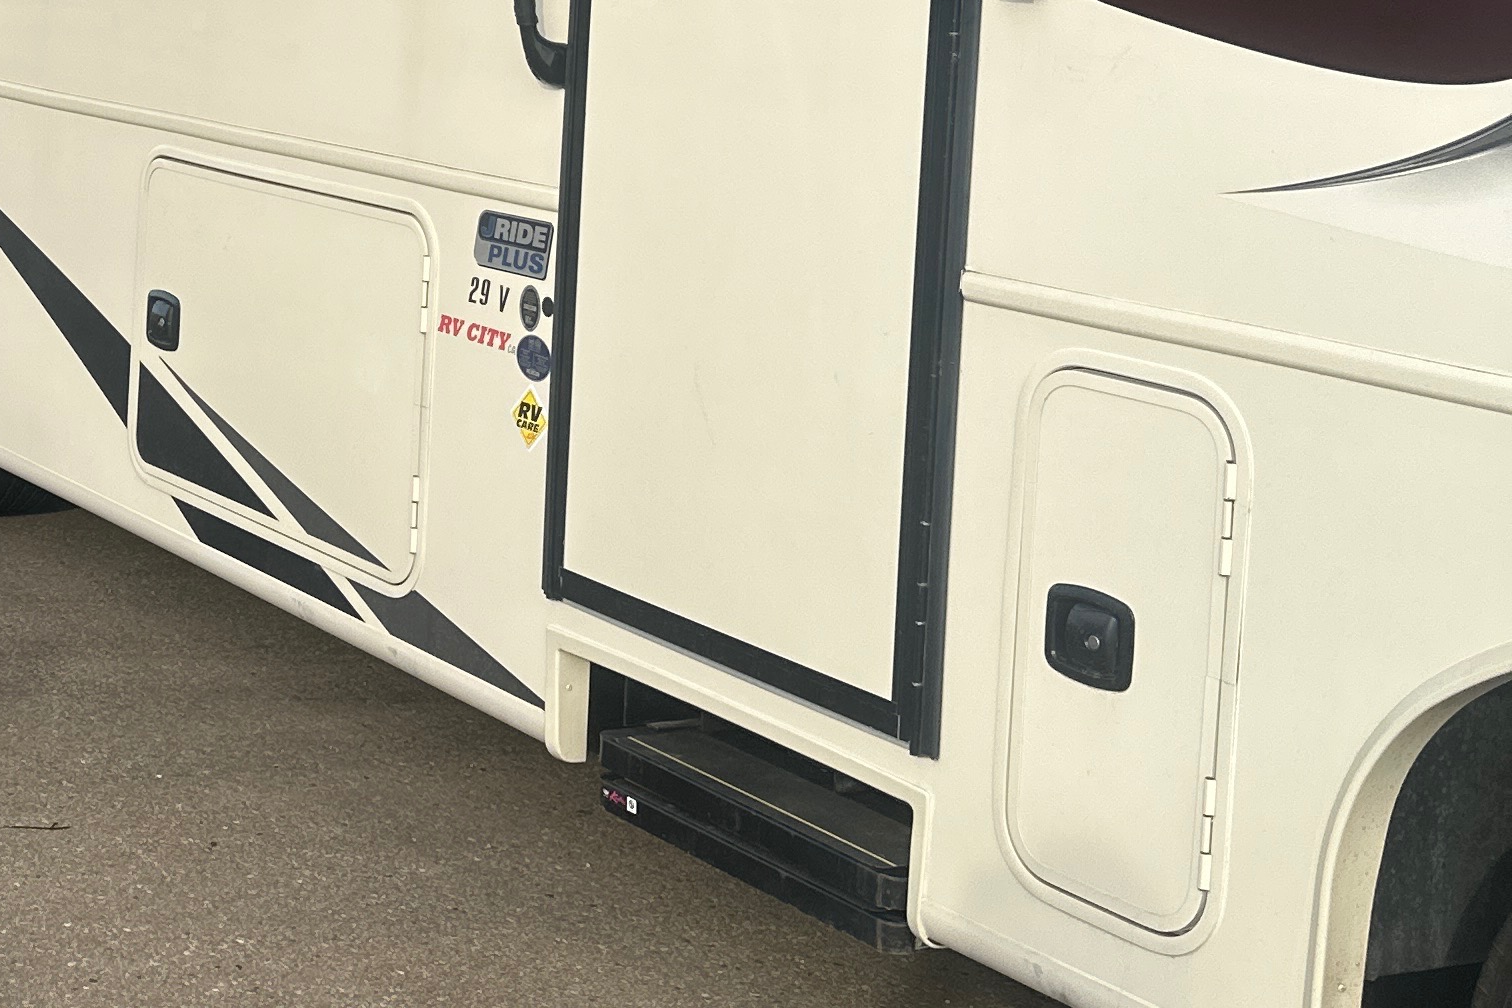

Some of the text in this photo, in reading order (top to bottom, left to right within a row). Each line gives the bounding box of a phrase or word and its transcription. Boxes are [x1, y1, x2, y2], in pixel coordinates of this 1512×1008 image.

[481, 216, 548, 249] JRIDE
[488, 244, 544, 273] PLUS
[468, 277, 491, 305] 29
[499, 284, 510, 312] V
[438, 314, 465, 337] RV
[467, 323, 512, 351] CITY
[516, 419, 540, 433] CARE
[518, 401, 543, 422] RV
